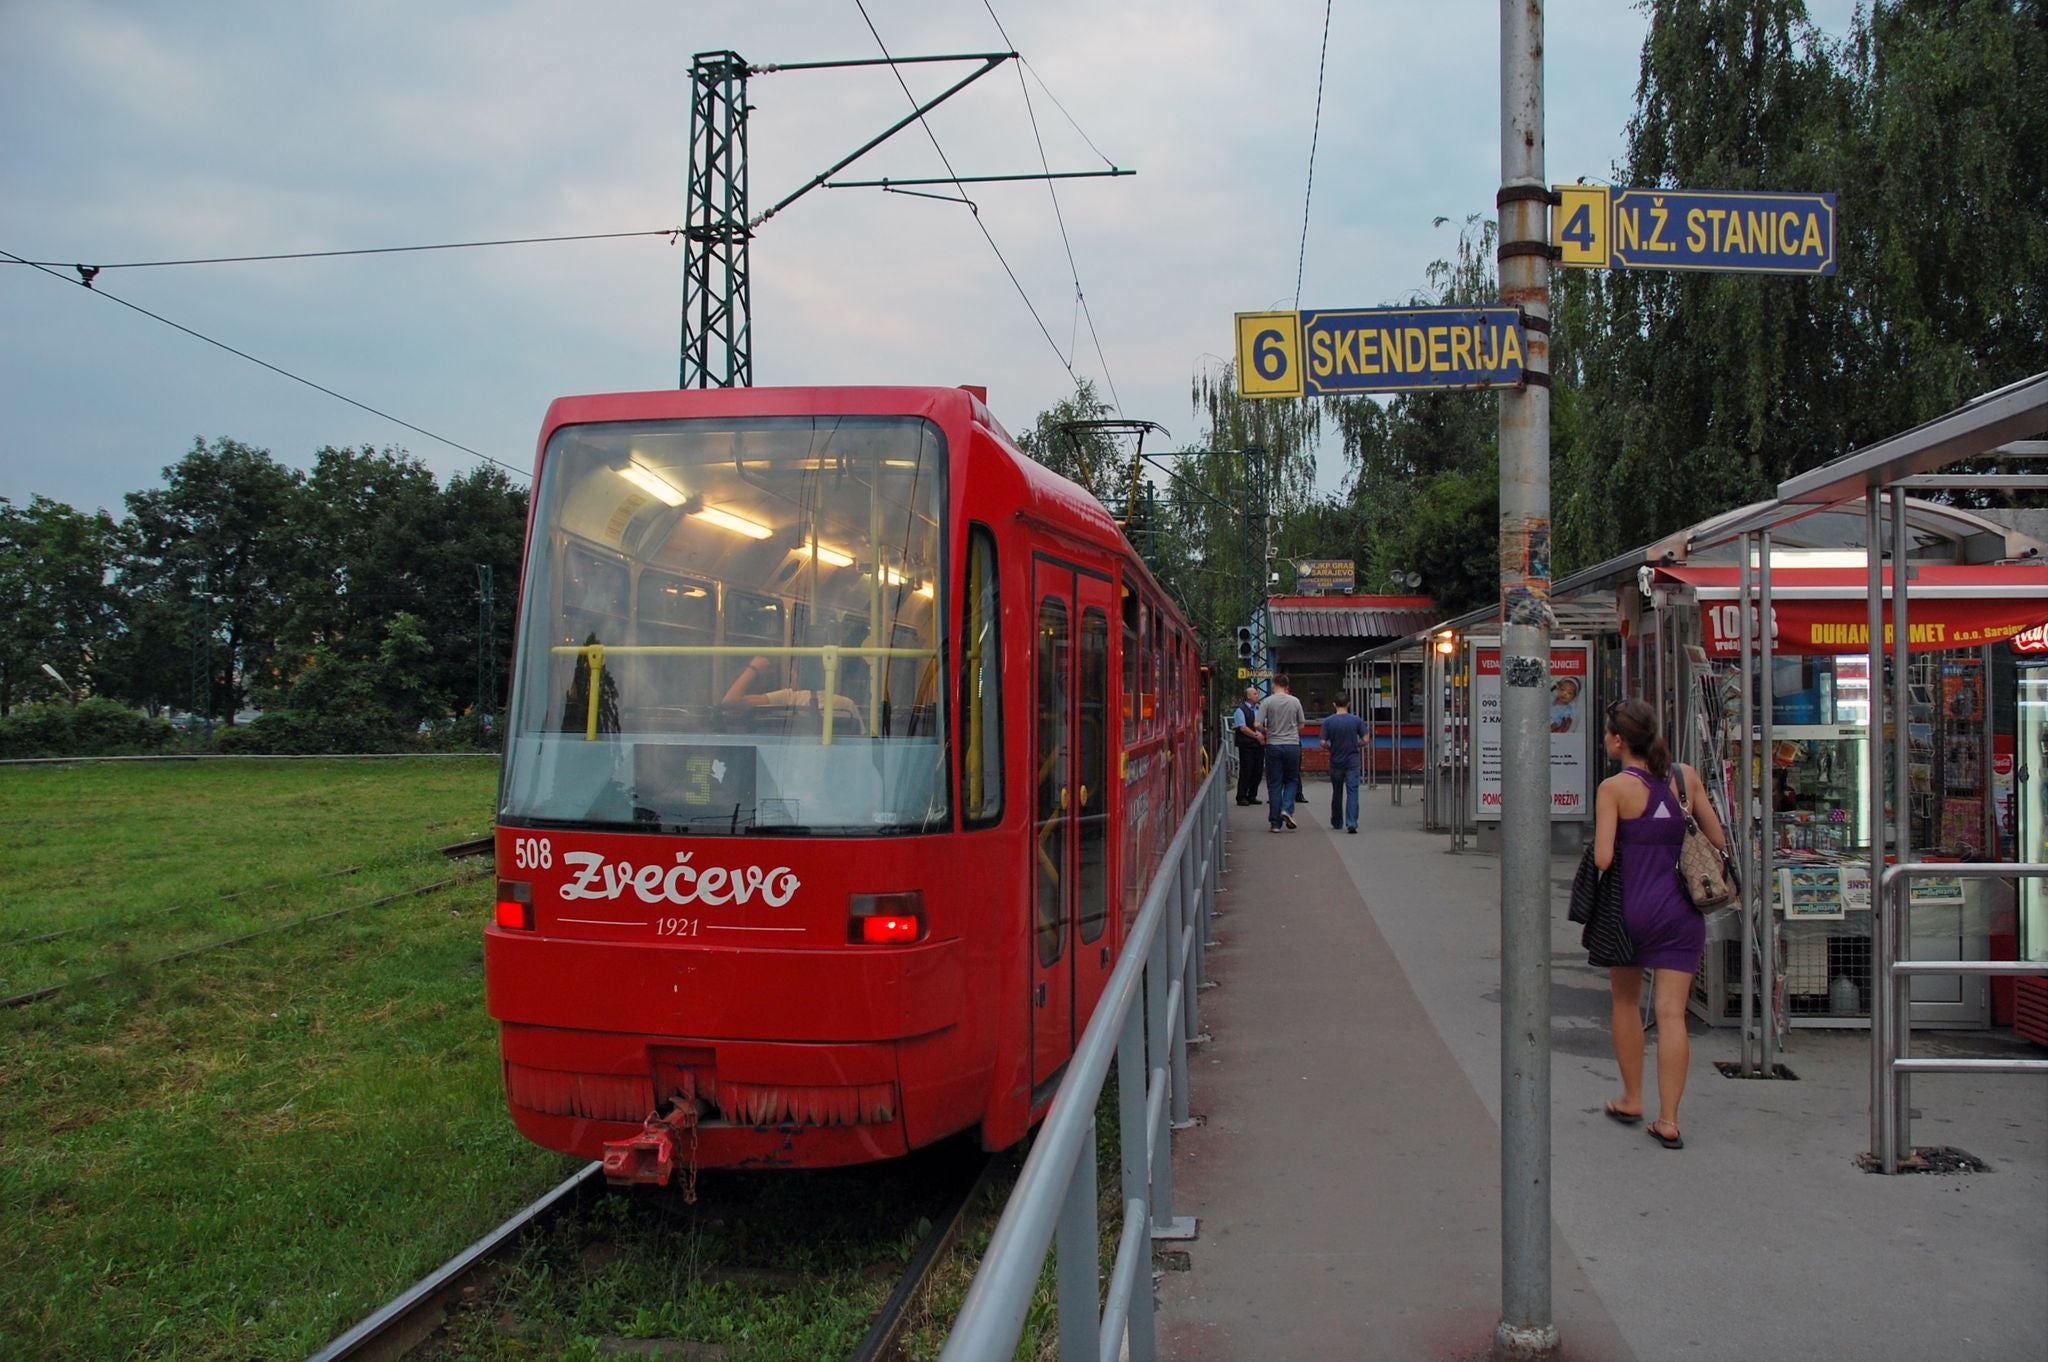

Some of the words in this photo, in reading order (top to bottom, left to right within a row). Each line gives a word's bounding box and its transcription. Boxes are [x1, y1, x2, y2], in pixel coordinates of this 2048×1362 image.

[1561, 203, 1596, 252] 4
[1617, 198, 1677, 252] N.Ž.
[1686, 208, 1824, 256] STANICA
[1252, 328, 1288, 382] 6
[1310, 326, 1524, 378] SKENDERIJA
[1311, 569, 1354, 577] SARAJEVO
[1811, 623, 1869, 644] DUHAN
[1953, 631, 1982, 641] d.o.o.
[1482, 660, 1501, 668] VEDA
[686, 757, 711, 805] 3
[1553, 790, 1580, 806] PREŽIVI
[515, 838, 553, 870] 508
[559, 851, 801, 907] Zvečevo
[655, 917, 699, 937] 1921
